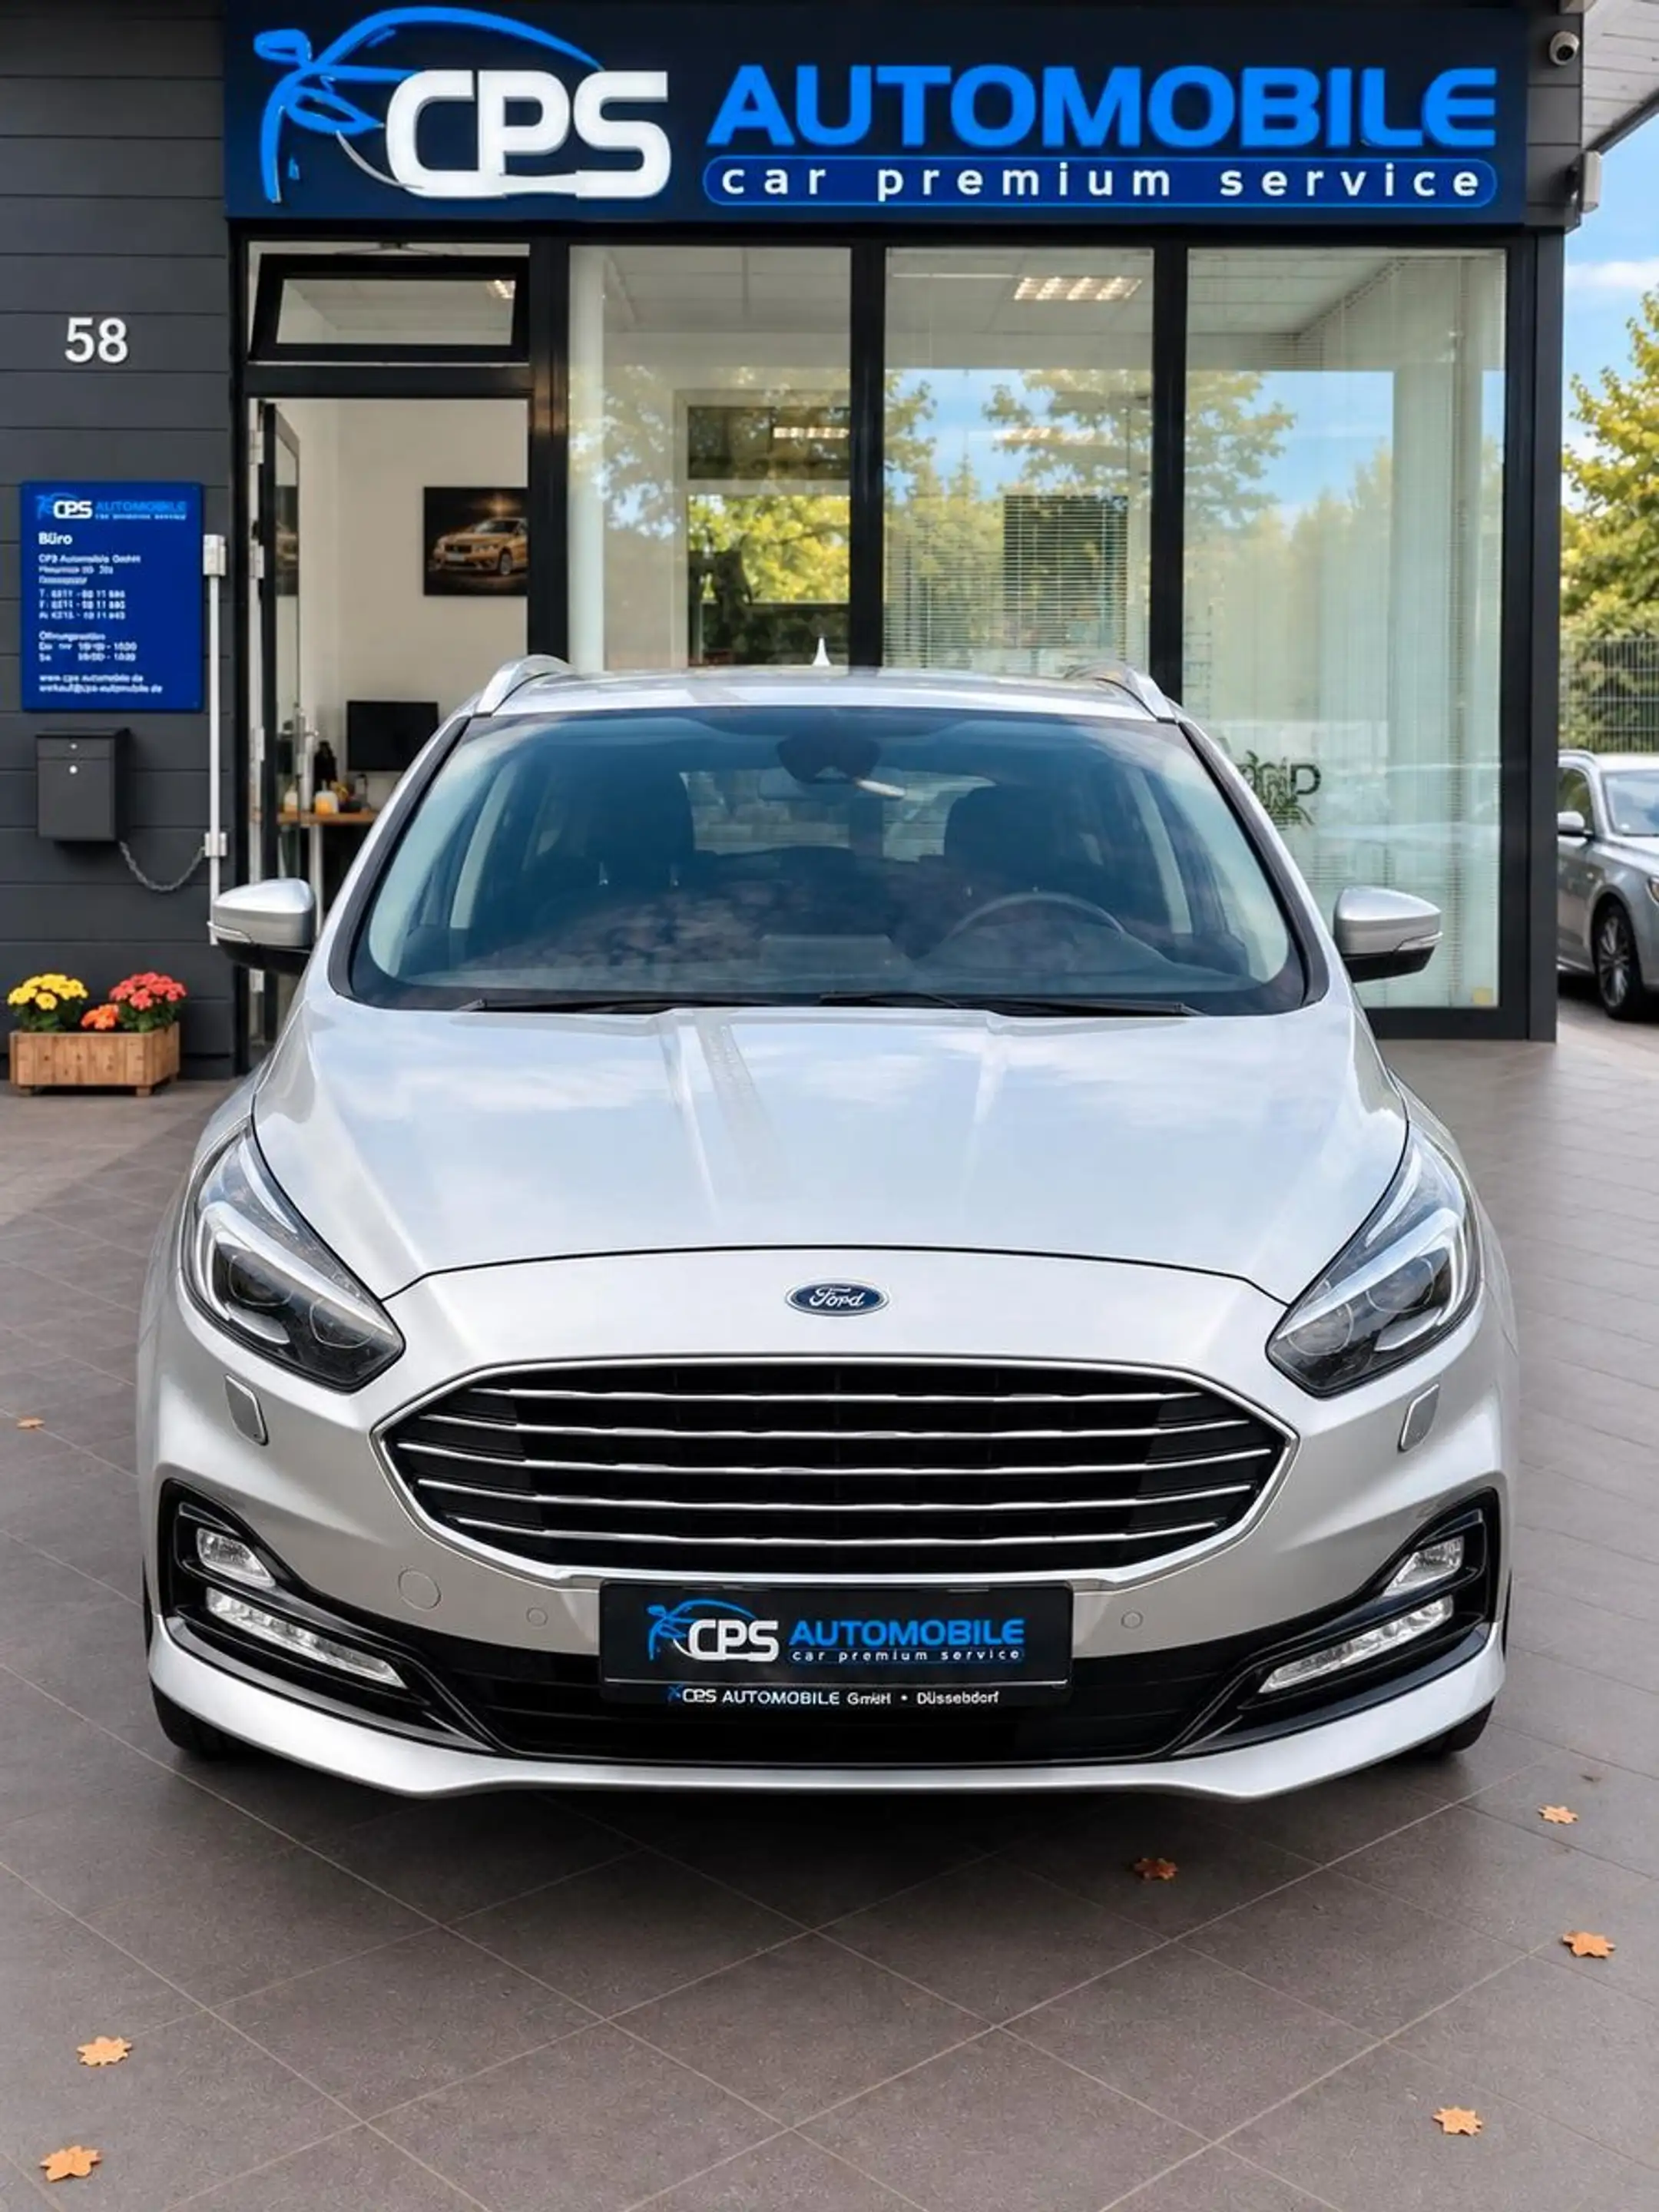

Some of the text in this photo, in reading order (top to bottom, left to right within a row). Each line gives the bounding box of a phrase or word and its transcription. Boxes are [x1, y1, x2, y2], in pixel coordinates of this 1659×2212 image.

[386, 65, 1496, 199] CPS AUTOMOBILE
[722, 162, 1479, 202] car premium service
[65, 316, 128, 363] 58
[38, 532, 72, 545] Büro
[809, 1286, 866, 1307] Ford
[688, 1619, 1025, 1662] CPS AUTOMOBILE
[792, 1650, 1019, 1663] car premium service
[722, 1690, 840, 1705] AUTOMOBILE
